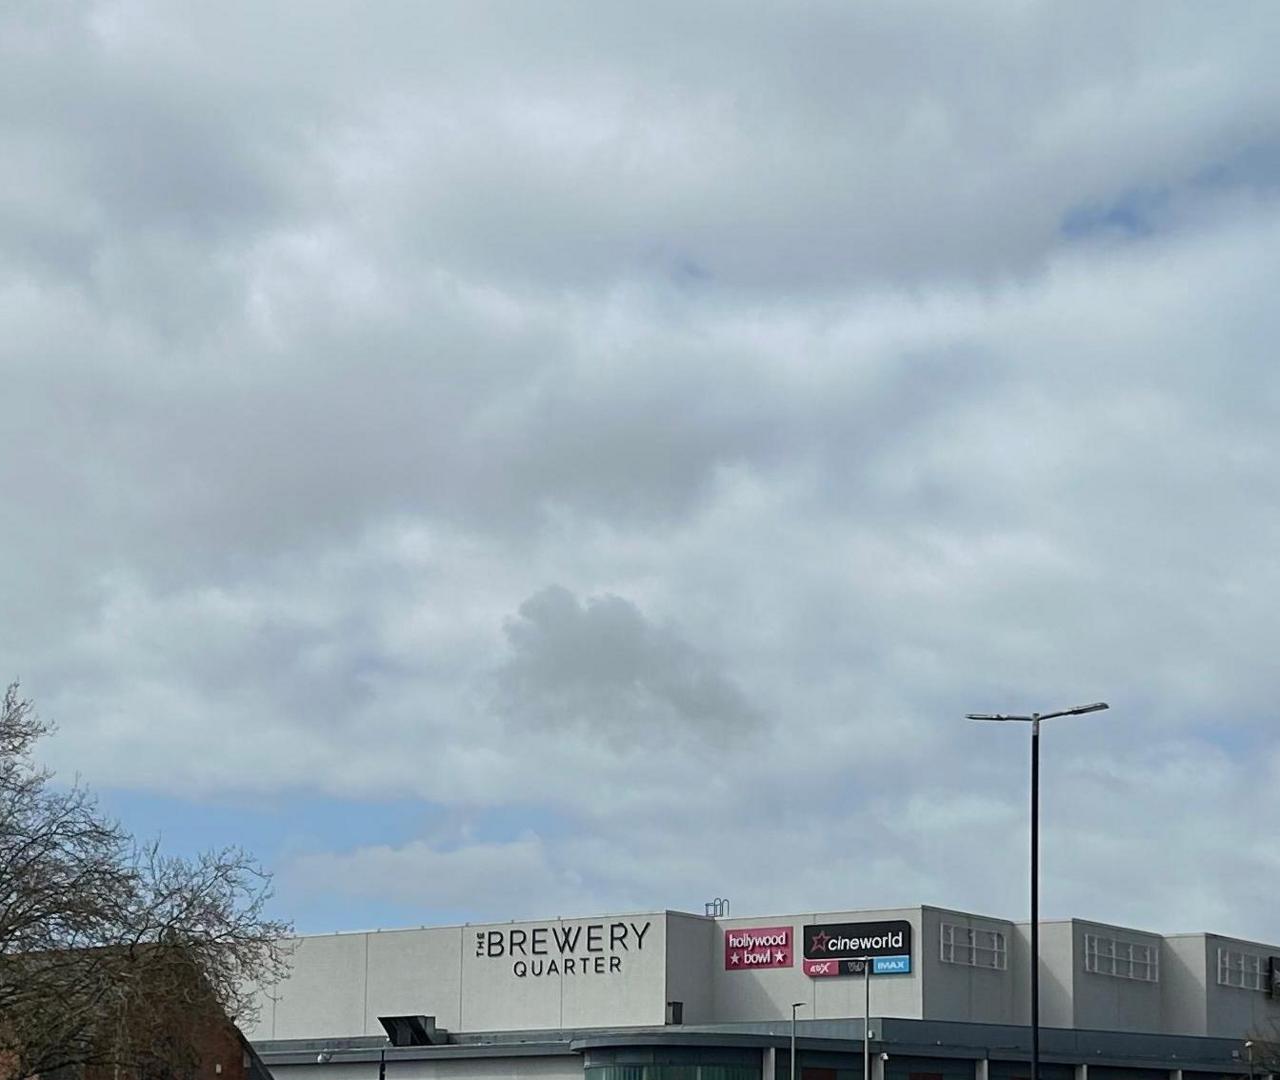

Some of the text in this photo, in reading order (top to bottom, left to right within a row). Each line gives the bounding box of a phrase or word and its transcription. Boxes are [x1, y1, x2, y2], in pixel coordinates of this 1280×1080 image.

[476, 922, 651, 957] THE BREWERY
[728, 932, 787, 950] hollywood
[828, 932, 903, 951] cineworld
[744, 950, 771, 964] bowl
[877, 961, 905, 970] IMAX
[513, 956, 622, 977] QUARTER
